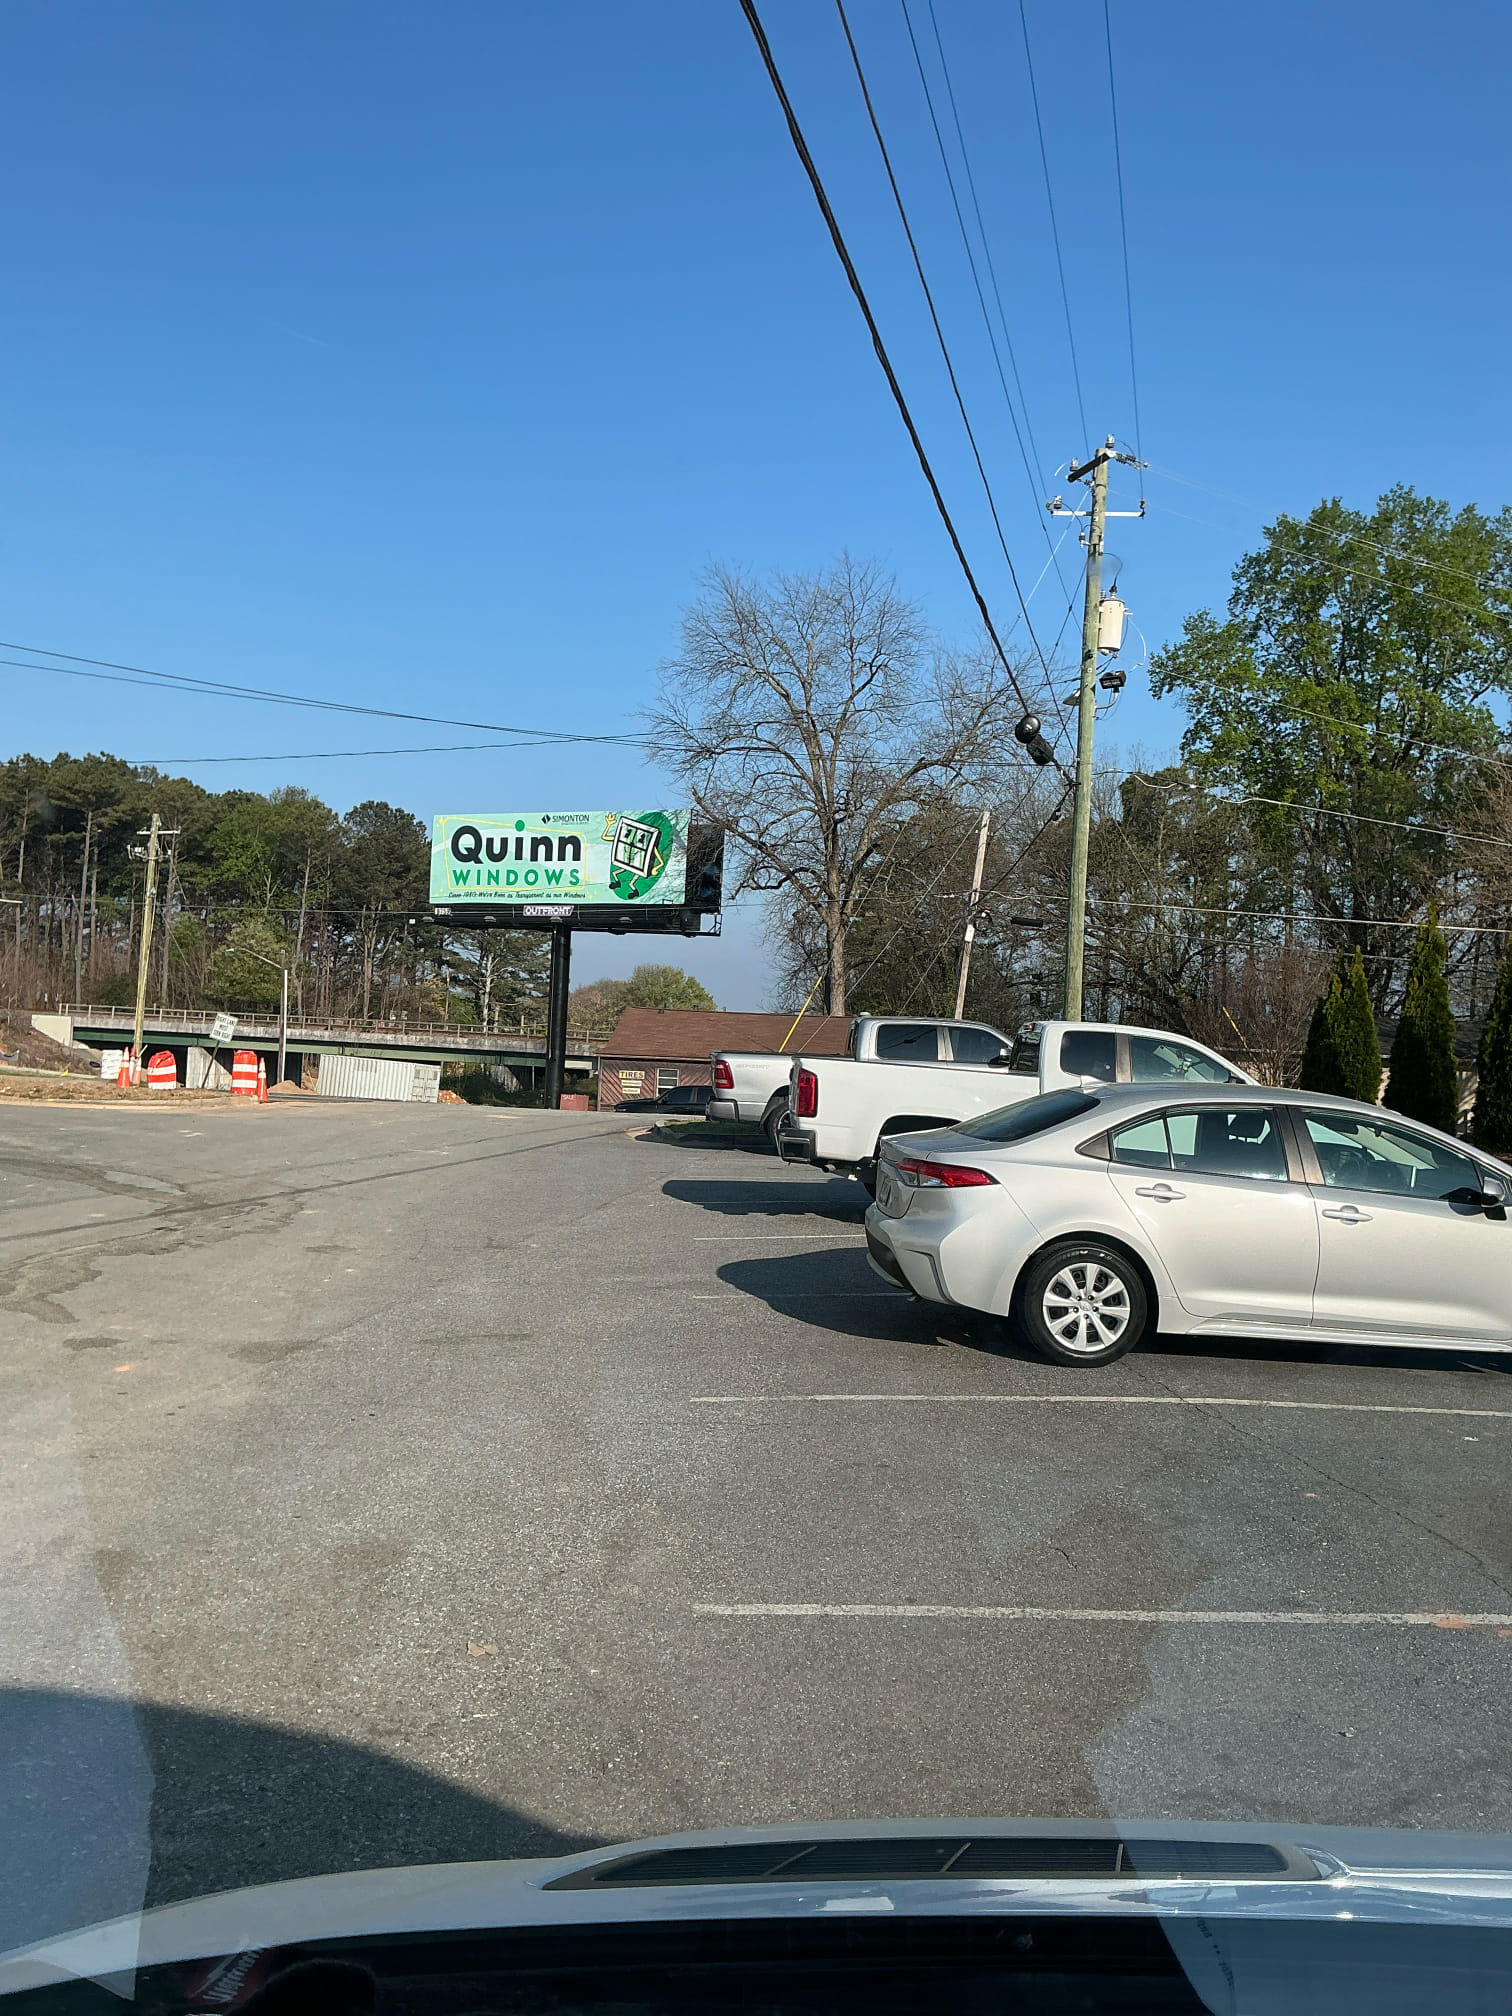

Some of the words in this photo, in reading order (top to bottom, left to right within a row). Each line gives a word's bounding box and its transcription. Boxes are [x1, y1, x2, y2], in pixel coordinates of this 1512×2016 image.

[552, 814, 590, 823] SIMONTON
[451, 820, 581, 864] Quinn
[452, 868, 580, 887] WINDOWS
[525, 906, 571, 915] OUTFRONT
[620, 1071, 644, 1079] TIRES
